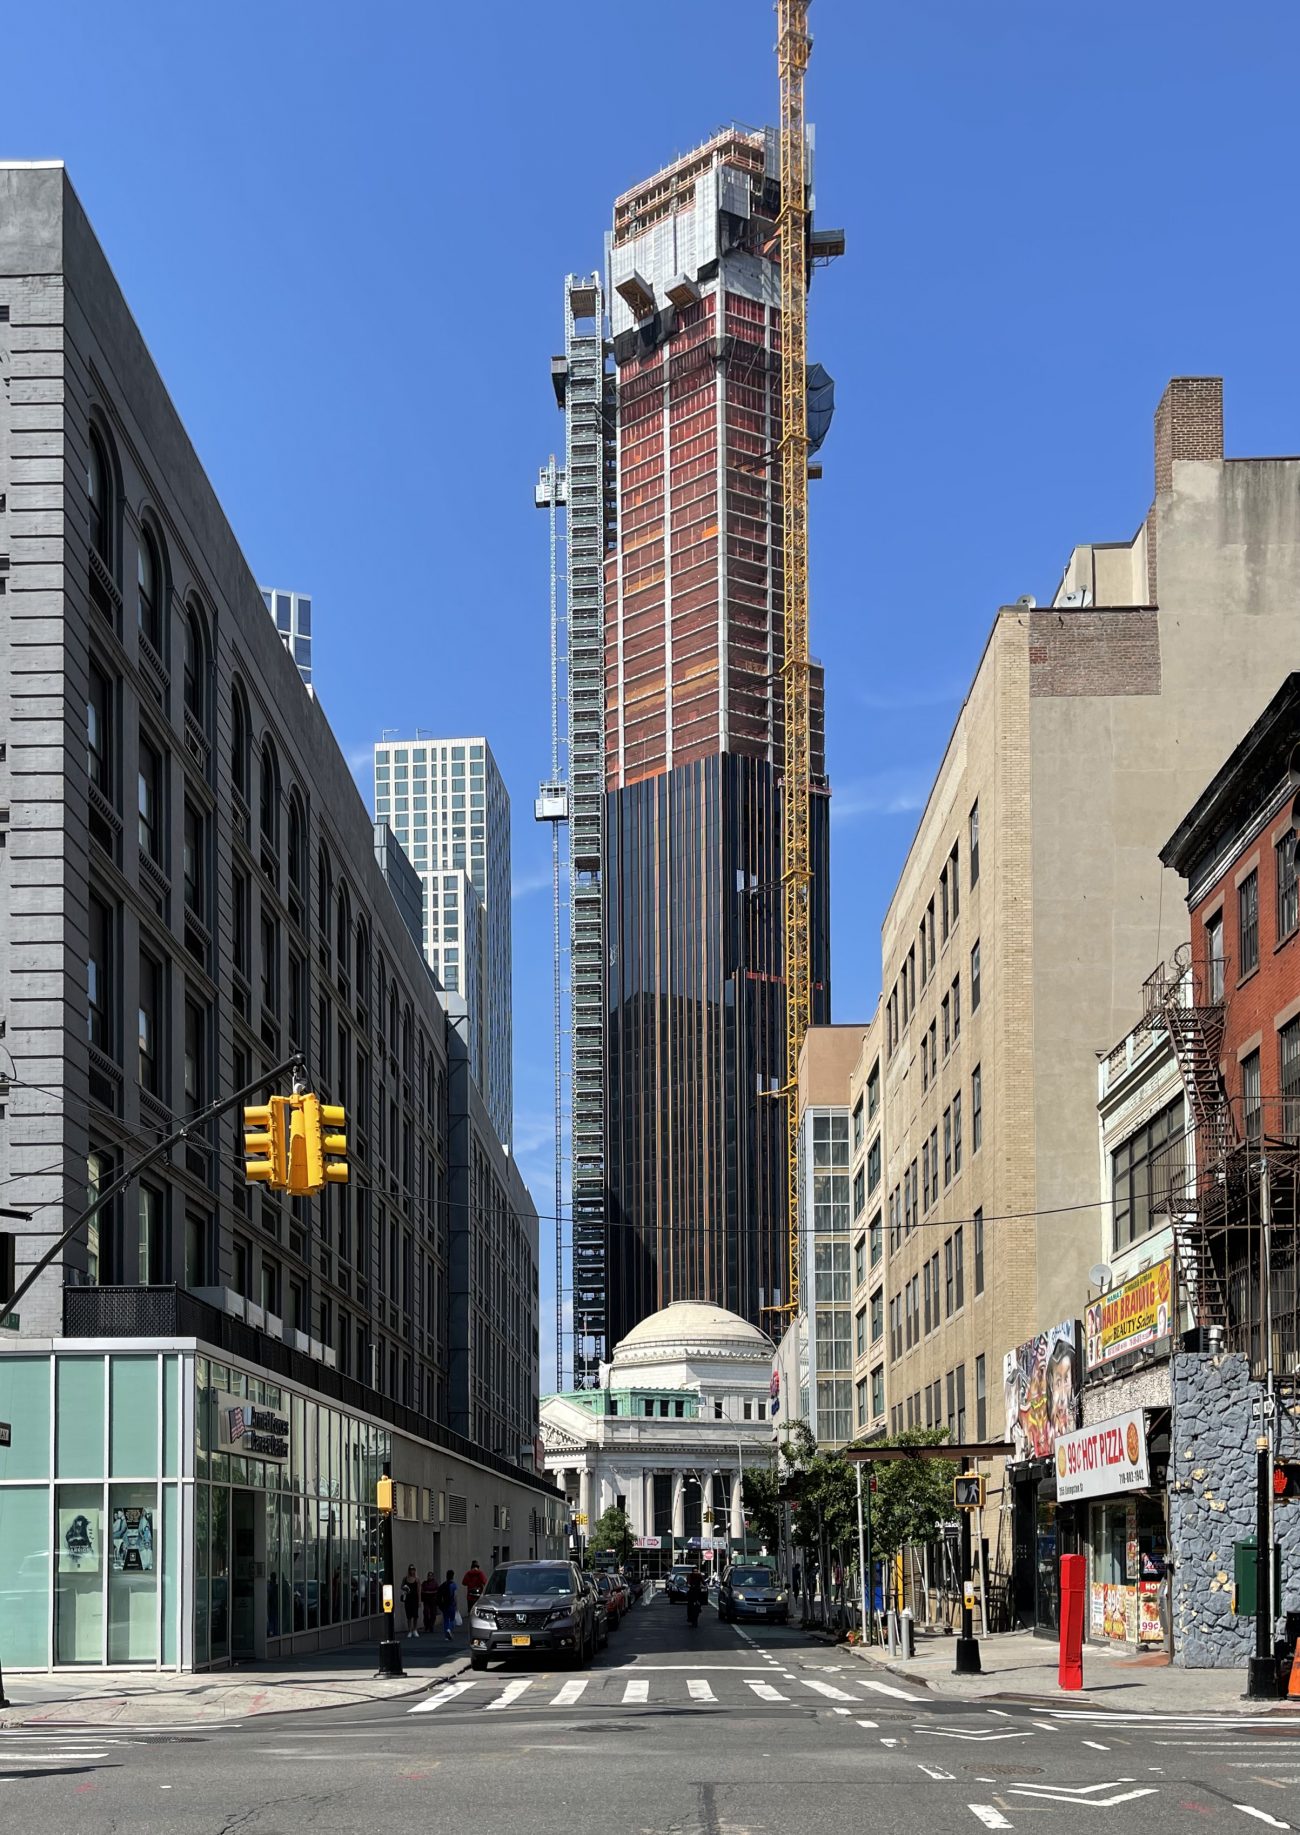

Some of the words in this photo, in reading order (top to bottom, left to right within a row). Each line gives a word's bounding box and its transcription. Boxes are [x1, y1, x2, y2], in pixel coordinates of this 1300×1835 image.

[1102, 1301, 1118, 1330] HAIR
[1113, 1318, 1136, 1340] BEAUTY
[1082, 1436, 1097, 1471] HOT
[1099, 1428, 1125, 1467] PIZZA
[1145, 1582, 1160, 1591] HOT
[1142, 1621, 1159, 1631] 99¢
